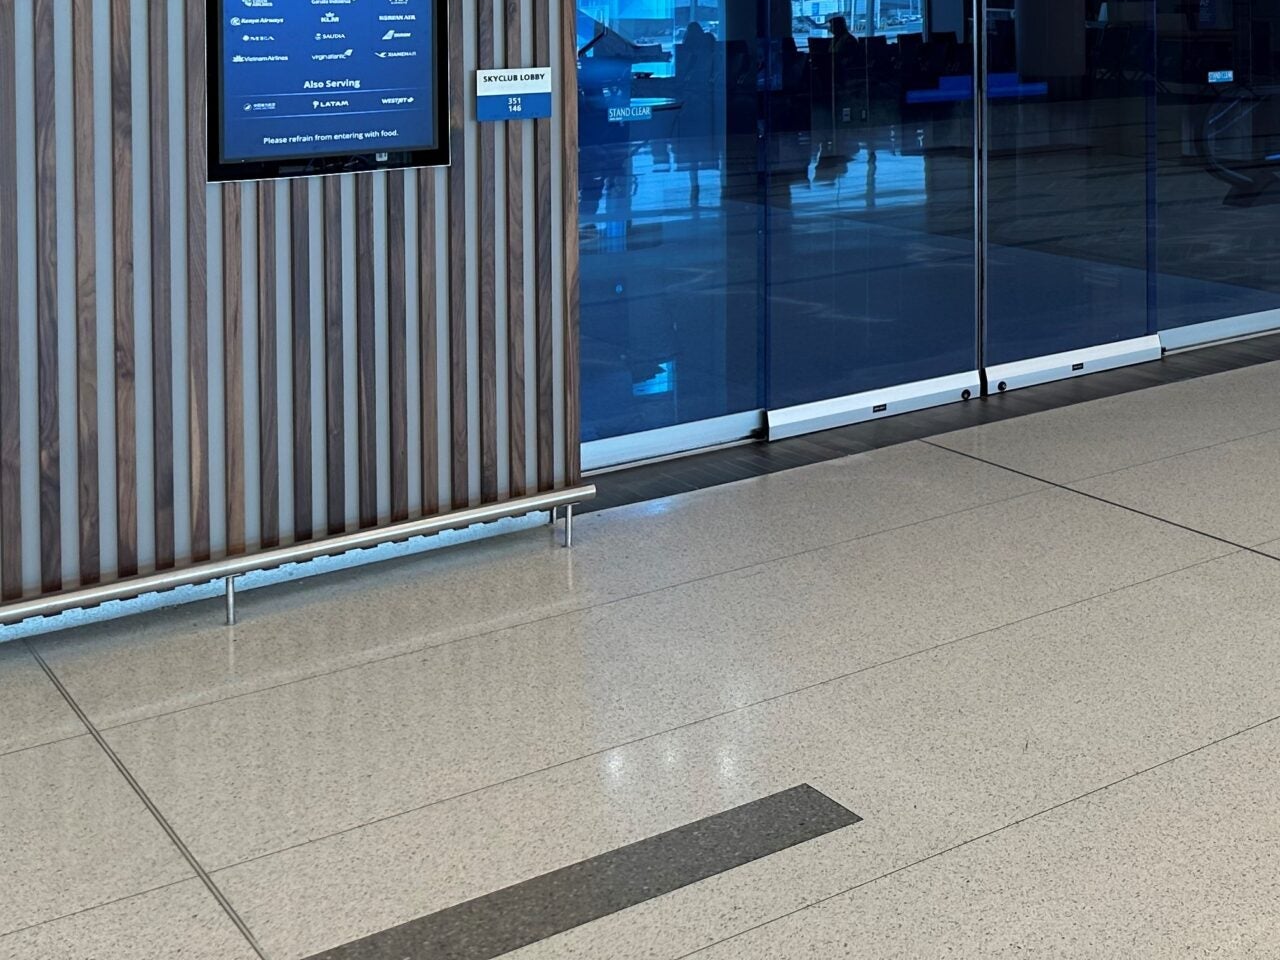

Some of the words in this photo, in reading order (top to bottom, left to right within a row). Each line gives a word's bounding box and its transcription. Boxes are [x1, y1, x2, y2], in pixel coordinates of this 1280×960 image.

[303, 80, 324, 89] Also
[326, 79, 360, 88] Serving
[609, 108, 630, 117] STAND
[632, 107, 650, 116] CLEAR
